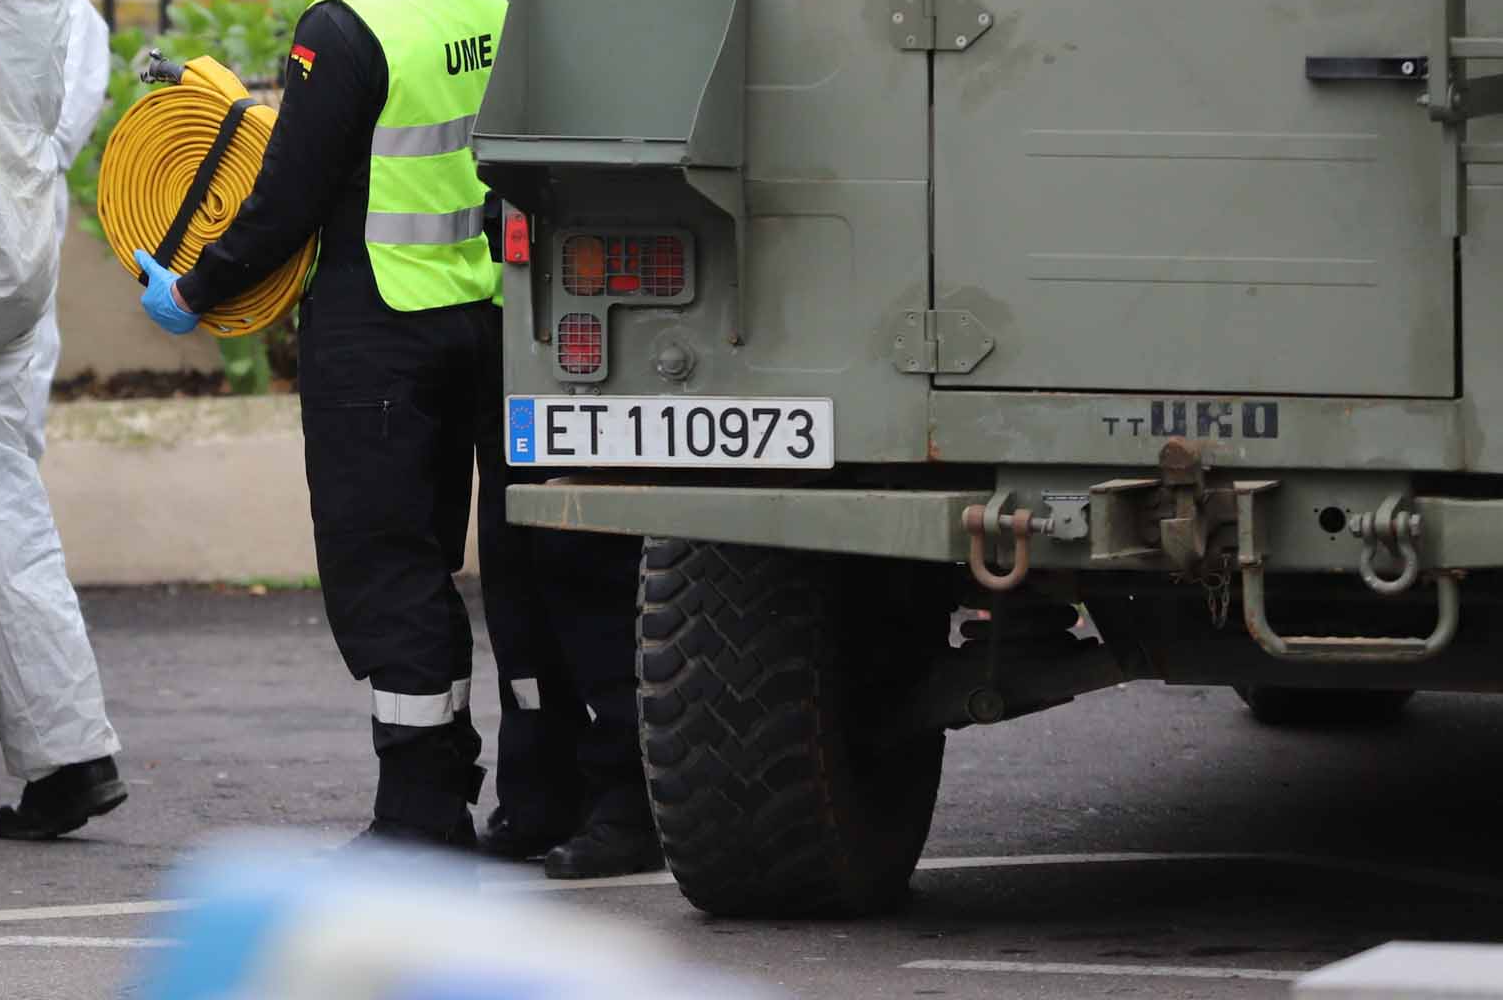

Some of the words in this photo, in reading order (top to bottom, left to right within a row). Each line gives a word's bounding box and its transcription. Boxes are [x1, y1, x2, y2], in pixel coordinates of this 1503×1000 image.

[444, 33, 493, 76] UME
[516, 438, 528, 453] E
[546, 405, 608, 456] ET
[627, 406, 816, 459] 110973
